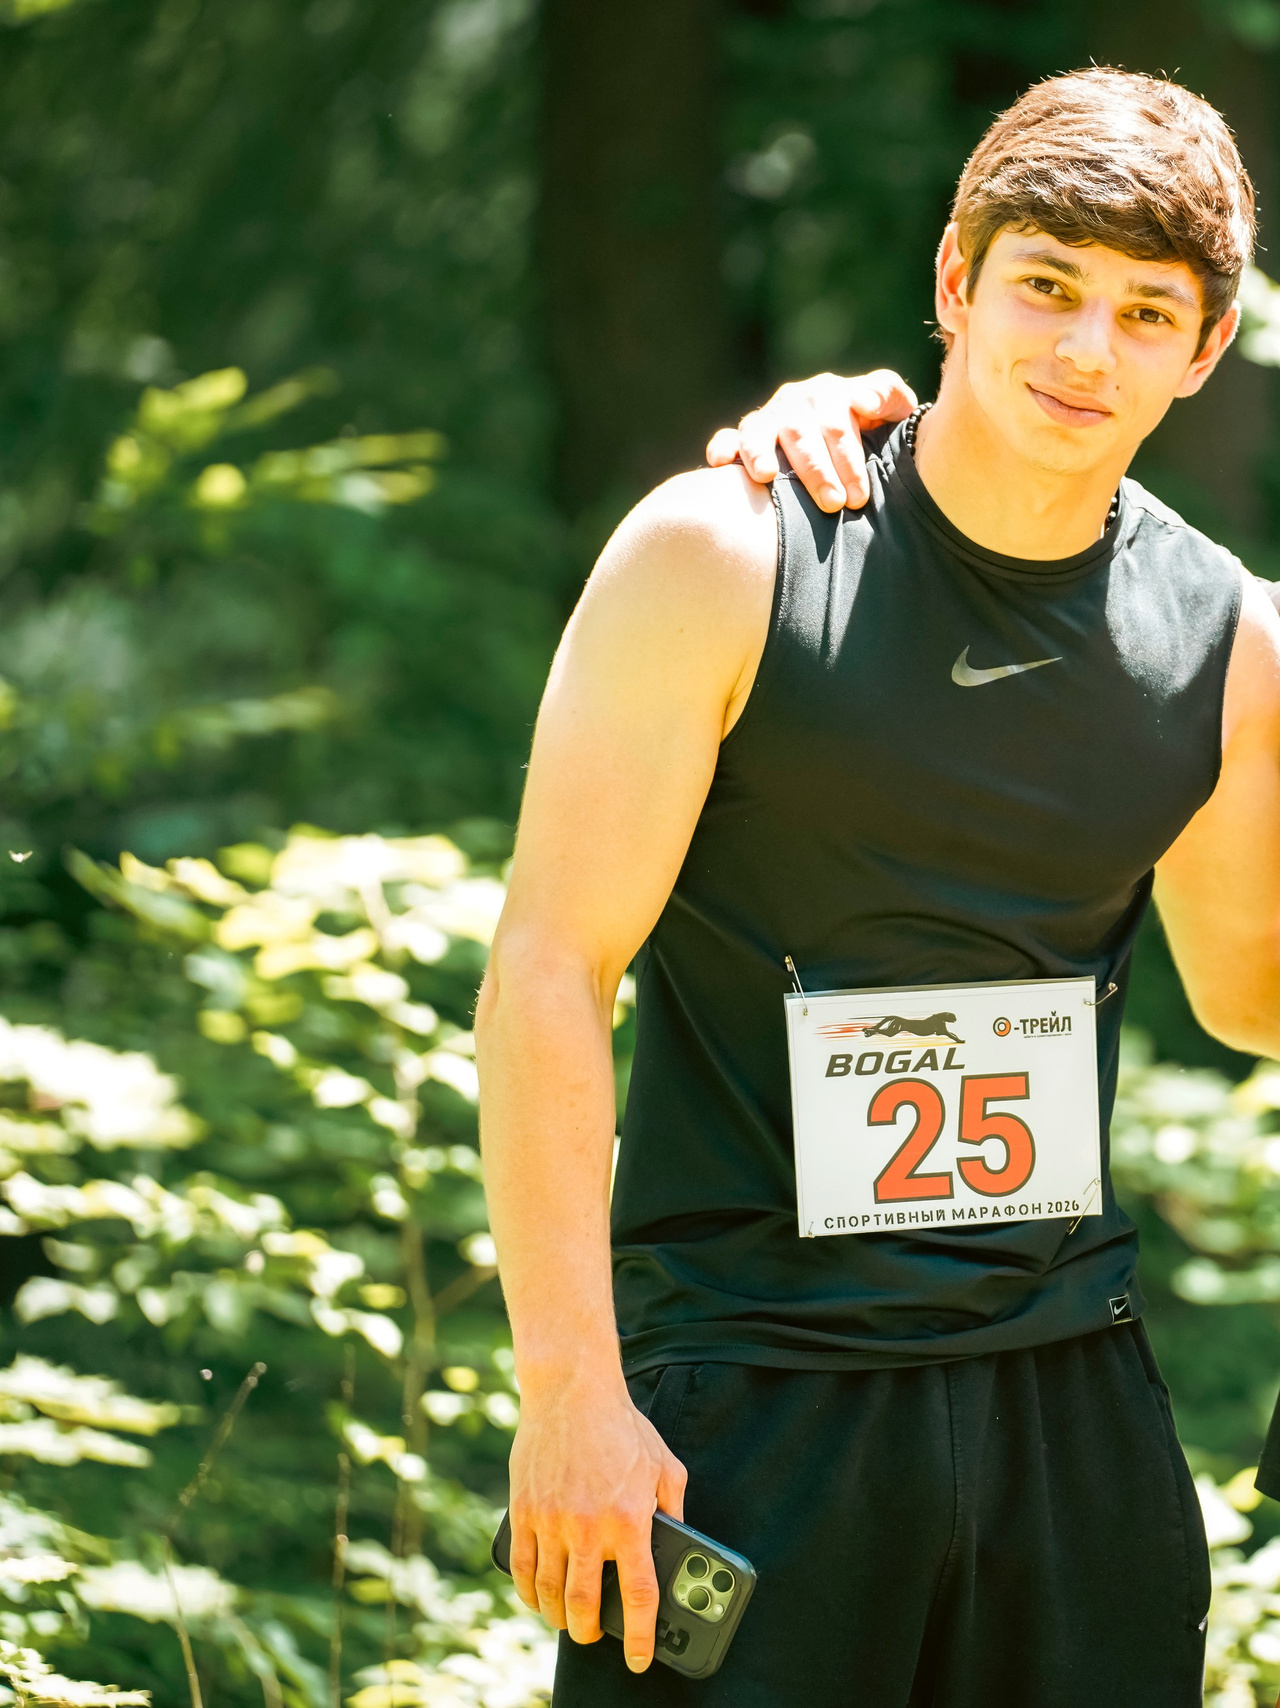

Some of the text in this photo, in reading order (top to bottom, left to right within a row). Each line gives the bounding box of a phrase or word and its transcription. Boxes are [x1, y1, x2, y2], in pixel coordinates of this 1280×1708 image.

[824, 1047, 966, 1078] BOGAL
[867, 1071, 1037, 1205] 25
[824, 1199, 1080, 1230] СПОРТИВНЫЙ МАРАФОН 2026
